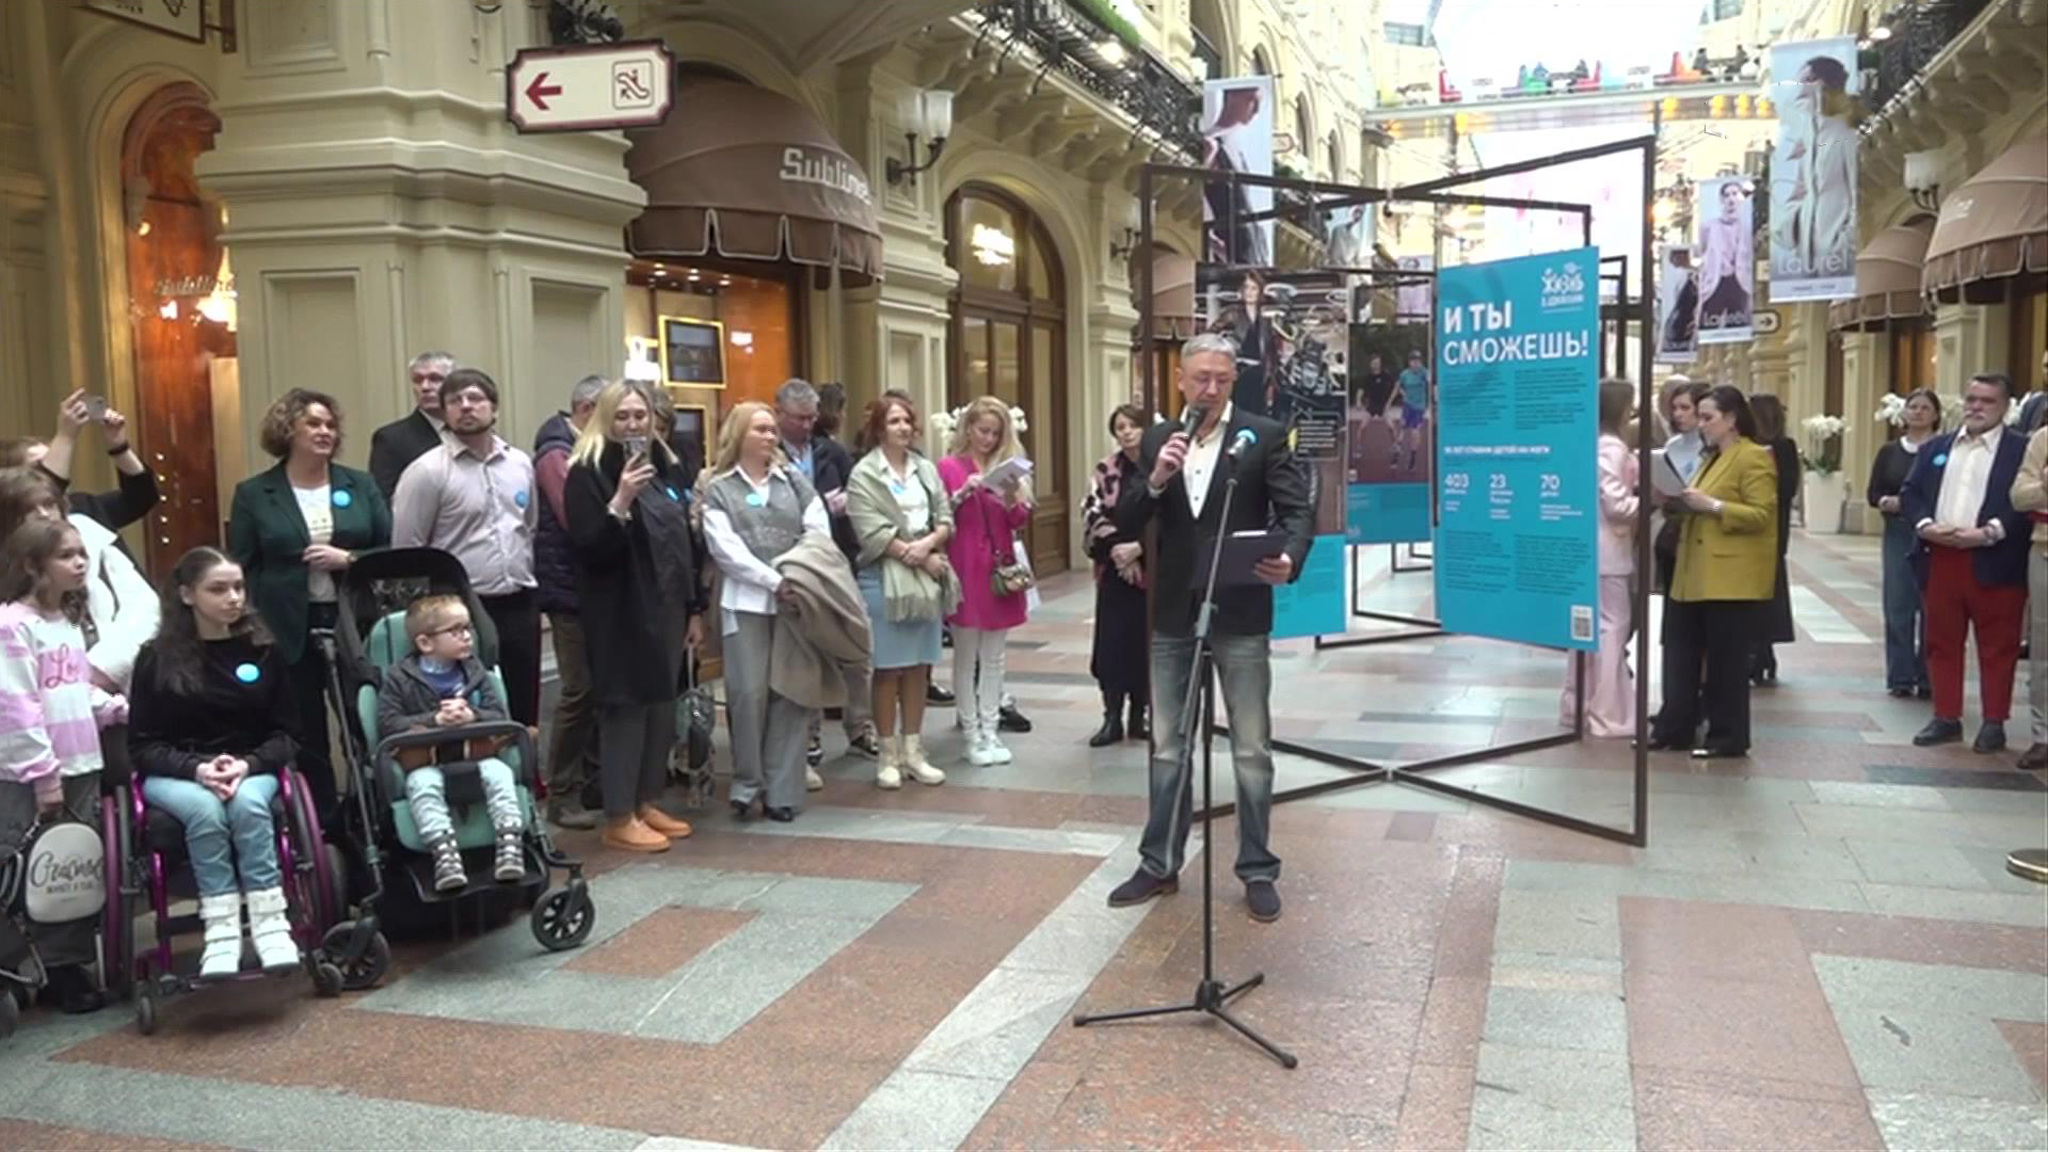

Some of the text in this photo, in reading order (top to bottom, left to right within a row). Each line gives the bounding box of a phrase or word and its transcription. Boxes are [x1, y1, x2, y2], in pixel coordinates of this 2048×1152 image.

[1444, 300, 1512, 334] И ТЫ
[1443, 329, 1589, 366] СМОЖЕШЬ!
[1490, 473, 1507, 489] 23
[1541, 474, 1561, 490] 70
